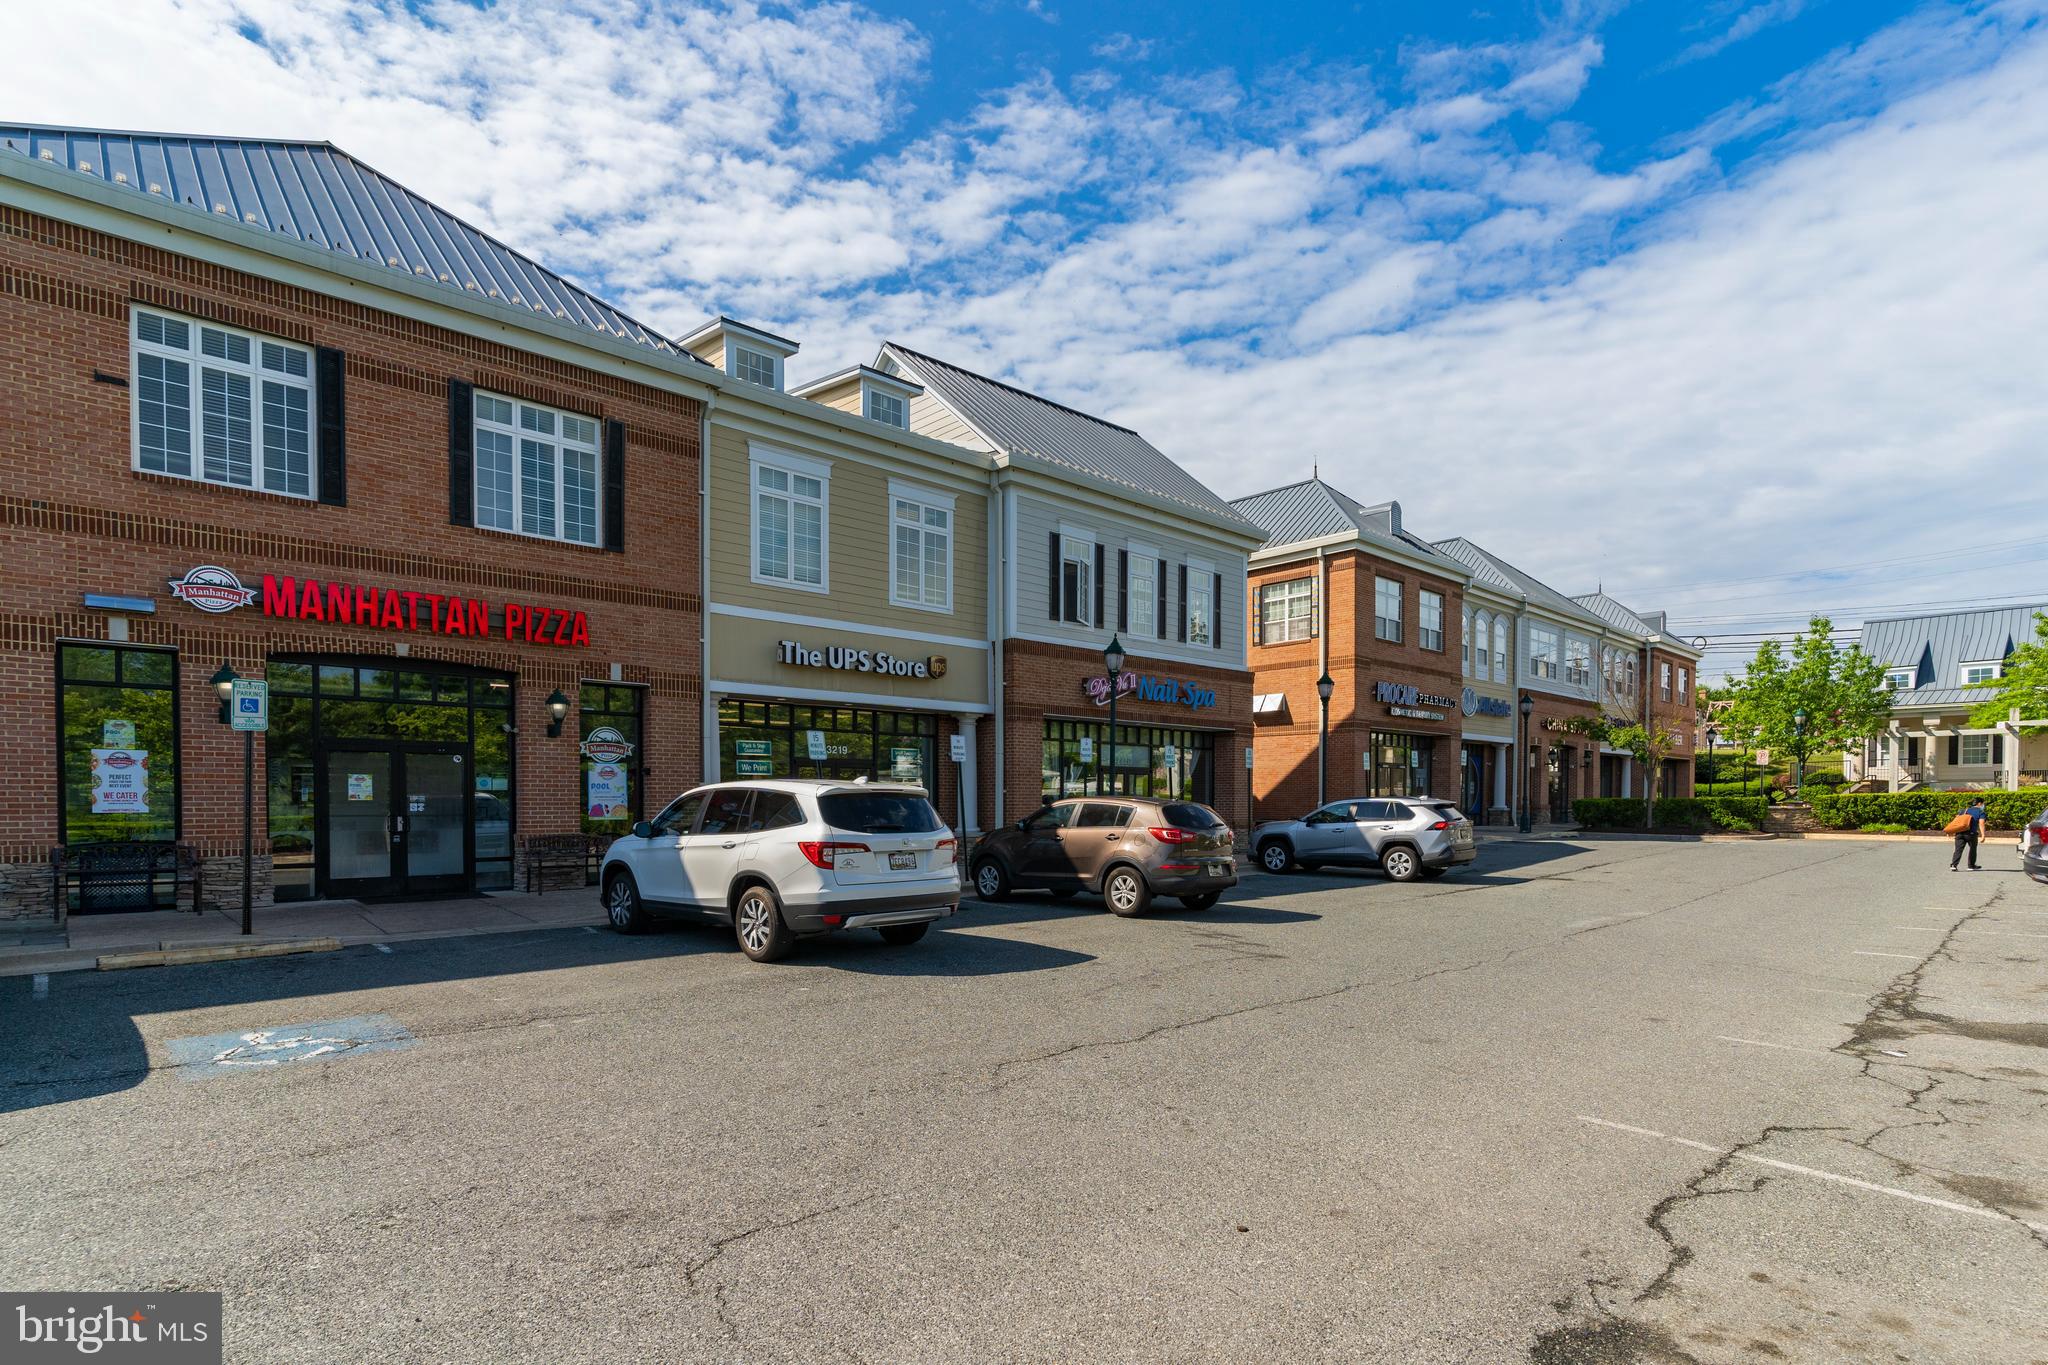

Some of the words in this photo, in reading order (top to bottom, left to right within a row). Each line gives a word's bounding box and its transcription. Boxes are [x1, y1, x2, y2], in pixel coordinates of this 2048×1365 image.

[188, 587, 239, 601] Manhattan
[263, 574, 489, 638] MANHATTAN
[505, 603, 591, 647] PIZZA
[780, 640, 822, 667] The
[826, 646, 871, 672] UPS
[873, 652, 926, 678] Store
[931, 661, 946, 676] ups
[236, 690, 263, 698] PARKING
[1138, 675, 1179, 704] Nail
[1180, 681, 1216, 711] Spa
[1377, 681, 1419, 706] PROCARE
[1419, 694, 1458, 709] PHARMACY
[590, 744, 624, 754] Manhattan
[742, 763, 752, 771] We
[753, 763, 768, 771] Print
[103, 791, 114, 799] WE
[116, 791, 138, 800] CATER
